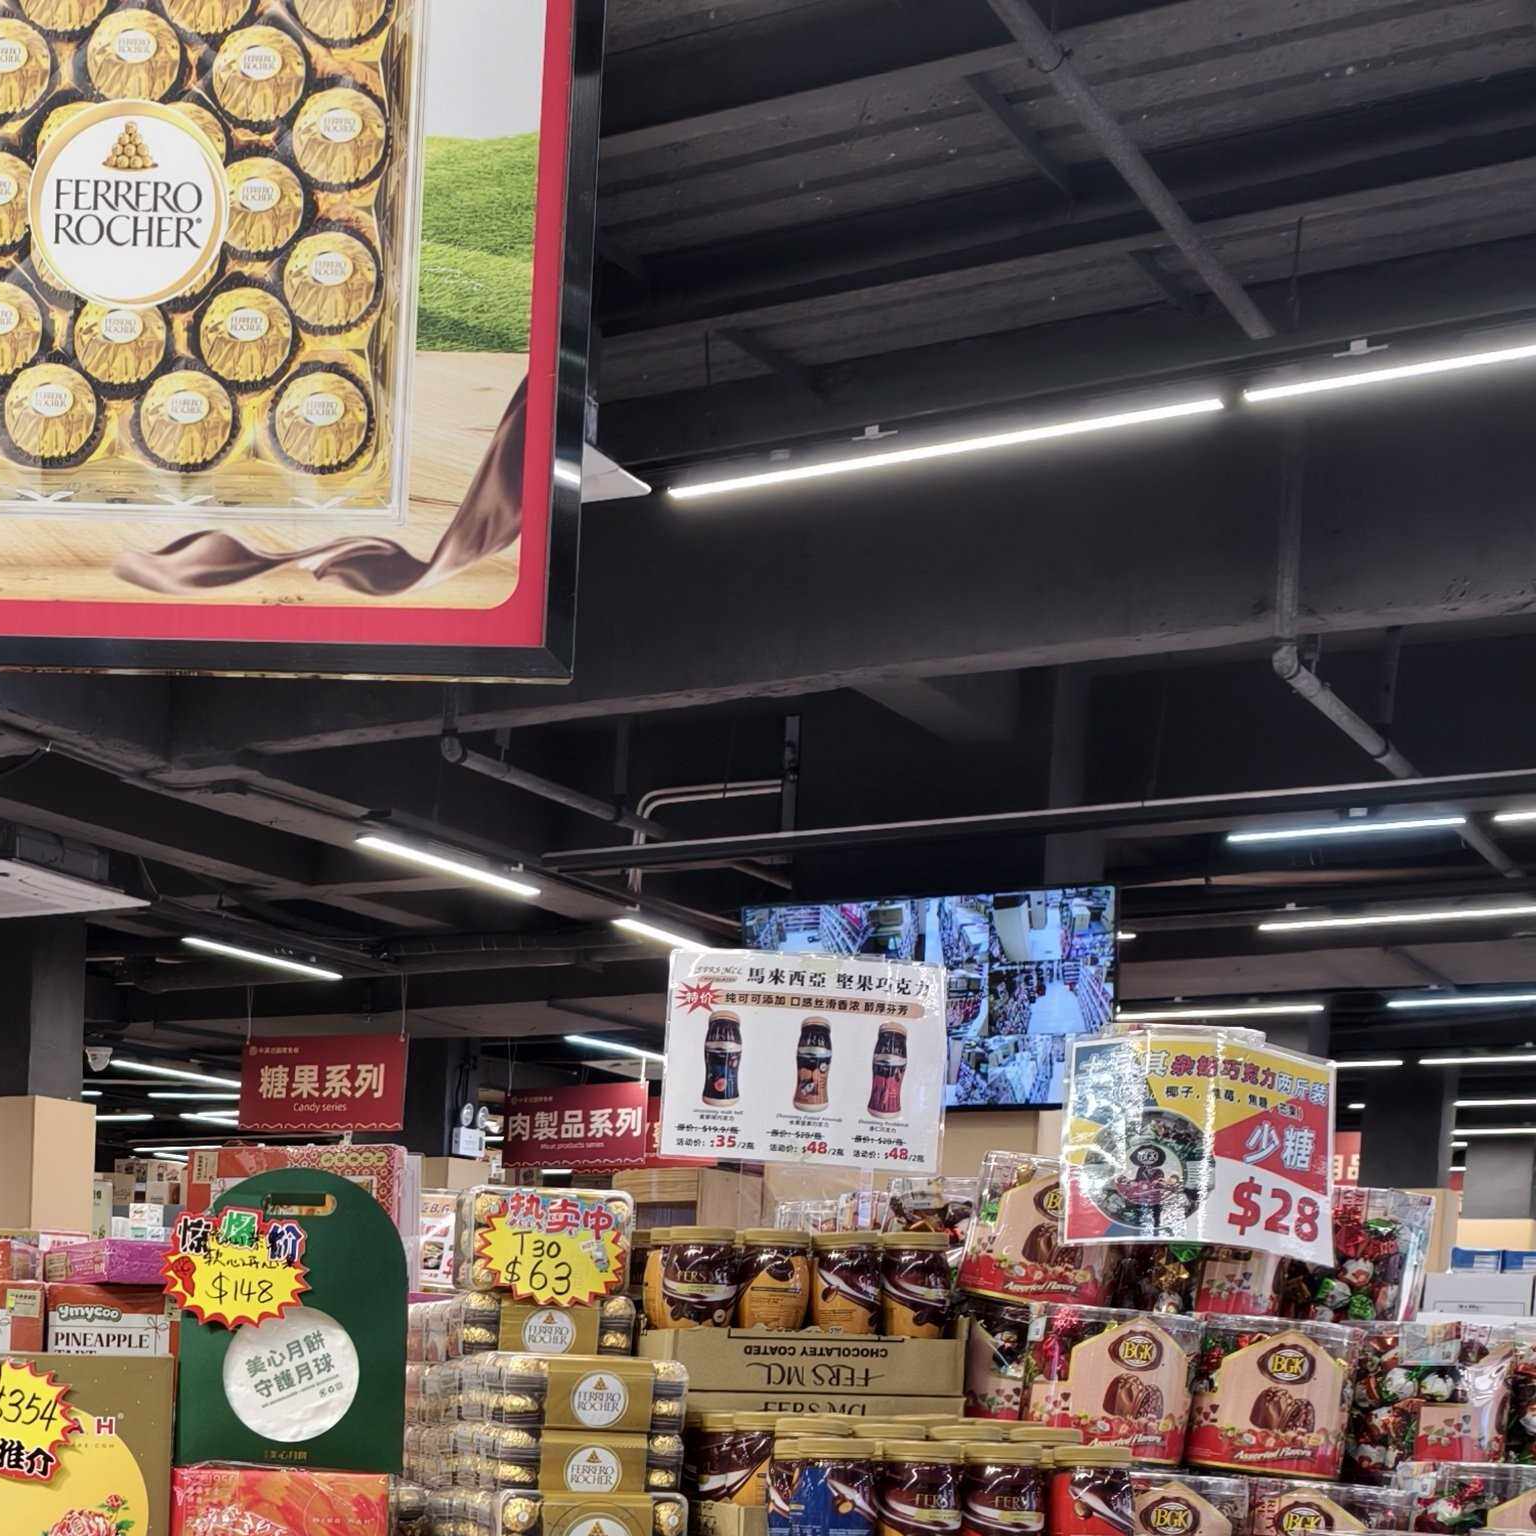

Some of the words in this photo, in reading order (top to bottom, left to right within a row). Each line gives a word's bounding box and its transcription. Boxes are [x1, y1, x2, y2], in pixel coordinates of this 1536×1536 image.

[53, 178, 203, 212] FERRERO
[52, 213, 199, 249] ROCHER
[747, 966, 827, 988] 馬來西亞
[835, 972, 931, 997] 堅果巧克力
[724, 992, 787, 1006] 纯可可添加
[259, 1063, 386, 1101] 糖果系列
[292, 1102, 321, 1114] Candy
[322, 1103, 348, 1113] series
[508, 1106, 644, 1142] 肉製品系列
[1242, 1120, 1316, 1172] 少糖
[506, 1190, 615, 1241] 热卖中
[1228, 1175, 1321, 1243] $28
[513, 1230, 562, 1260] T30
[205, 1271, 275, 1305] $148
[505, 1259, 573, 1299] $63
[58, 1304, 123, 1323] ymycoo
[54, 1328, 151, 1349] PINEAPPLE
[528, 1325, 574, 1336] FERRERO
[528, 1334, 573, 1345] ROCHER
[244, 1330, 327, 1379] 美心月餅
[743, 1345, 796, 1358] COATED
[799, 1344, 889, 1359] CHOCOLATEY
[1123, 1339, 1155, 1361] BGK
[1272, 1353, 1303, 1375] BGK
[254, 1353, 336, 1399] 守護月球
[577, 1390, 622, 1404] FERRERO
[577, 1400, 621, 1413] ROCHER
[570, 1464, 615, 1477] FERRERO
[570, 1474, 614, 1486] ROCHER
[1155, 1509, 1188, 1530] BGK
